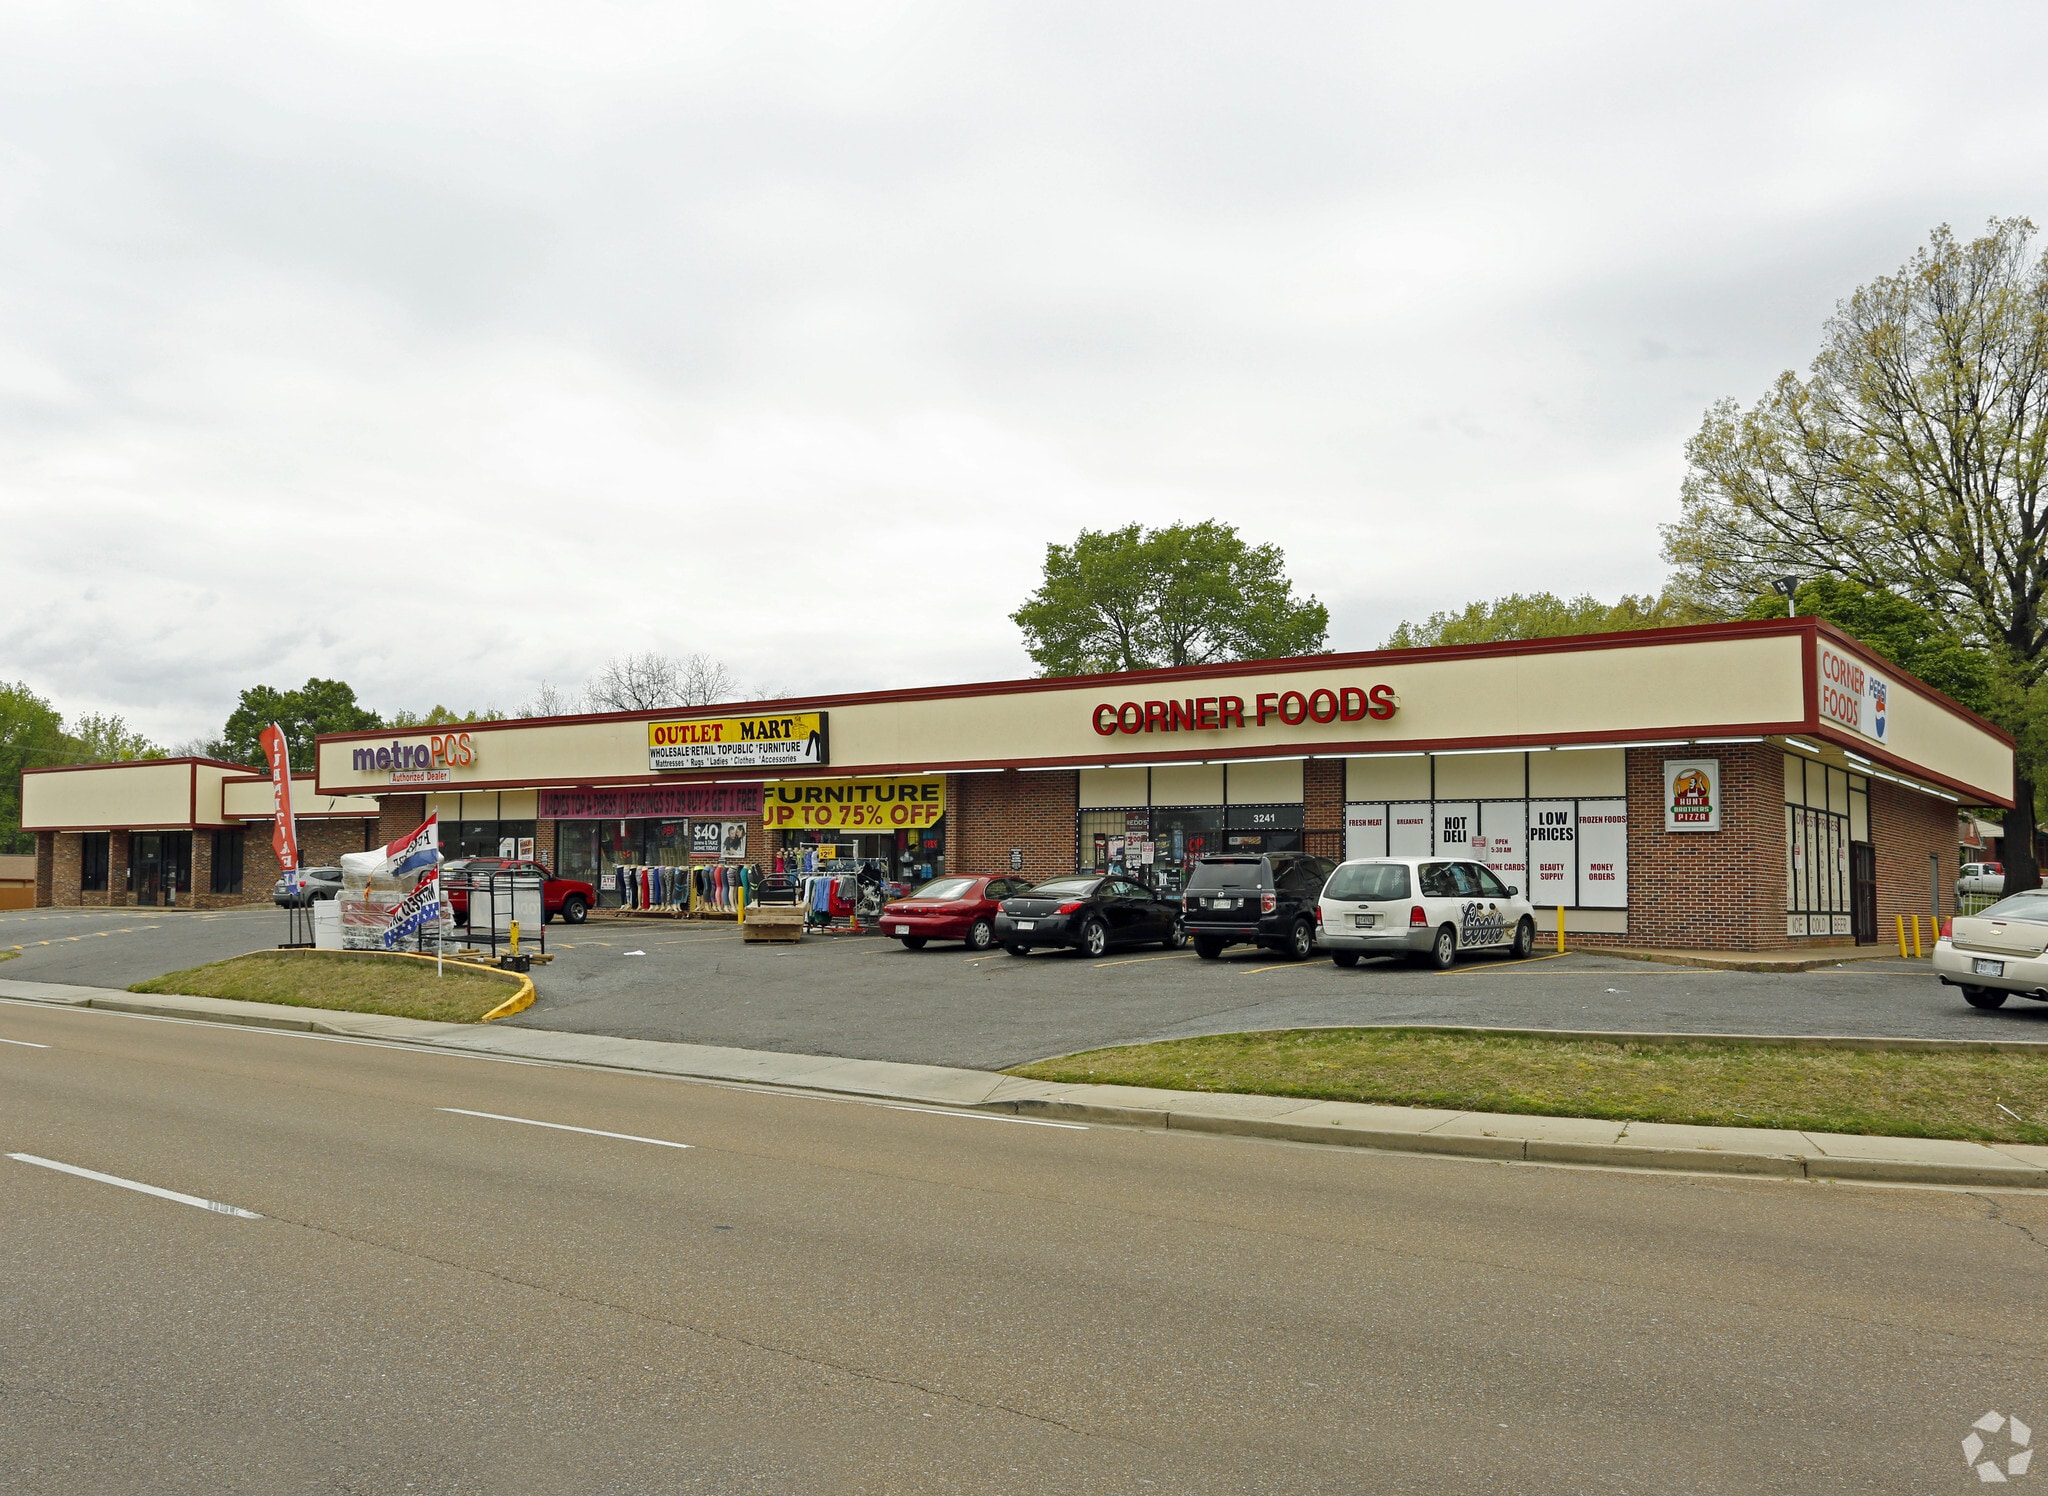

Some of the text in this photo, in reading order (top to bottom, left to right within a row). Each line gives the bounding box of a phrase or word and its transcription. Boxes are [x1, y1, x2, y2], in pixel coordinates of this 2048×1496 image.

[1823, 651, 1865, 697] CORNER
[1869, 676, 1887, 705] PEPSI
[1092, 685, 1396, 736] CORNER FOODS
[1823, 685, 1858, 727] FOODS
[654, 719, 794, 745] OUTLET MART
[353, 732, 474, 771] metroPCS
[655, 759, 684, 768] Mattresses
[392, 771, 447, 783] Authorized Dealer
[572, 794, 585, 815] TOP
[594, 793, 617, 815] DRESS
[712, 789, 727, 812] GET
[737, 788, 757, 812] FREE
[763, 784, 940, 804] FURNITURE
[801, 805, 832, 825] TO
[839, 805, 883, 825] 75%
[891, 804, 939, 825] OFF
[1253, 814, 1275, 823] 3241
[1539, 812, 1567, 825] LOW
[1579, 815, 1627, 824] FROZEN FOODS
[1349, 818, 1383, 827] FRESH MEAT
[1444, 816, 1467, 830] HOT
[694, 824, 719, 840] $40
[1443, 830, 1467, 843] DELI
[1530, 827, 1574, 841] PRICES
[1503, 863, 1526, 871] CARDS
